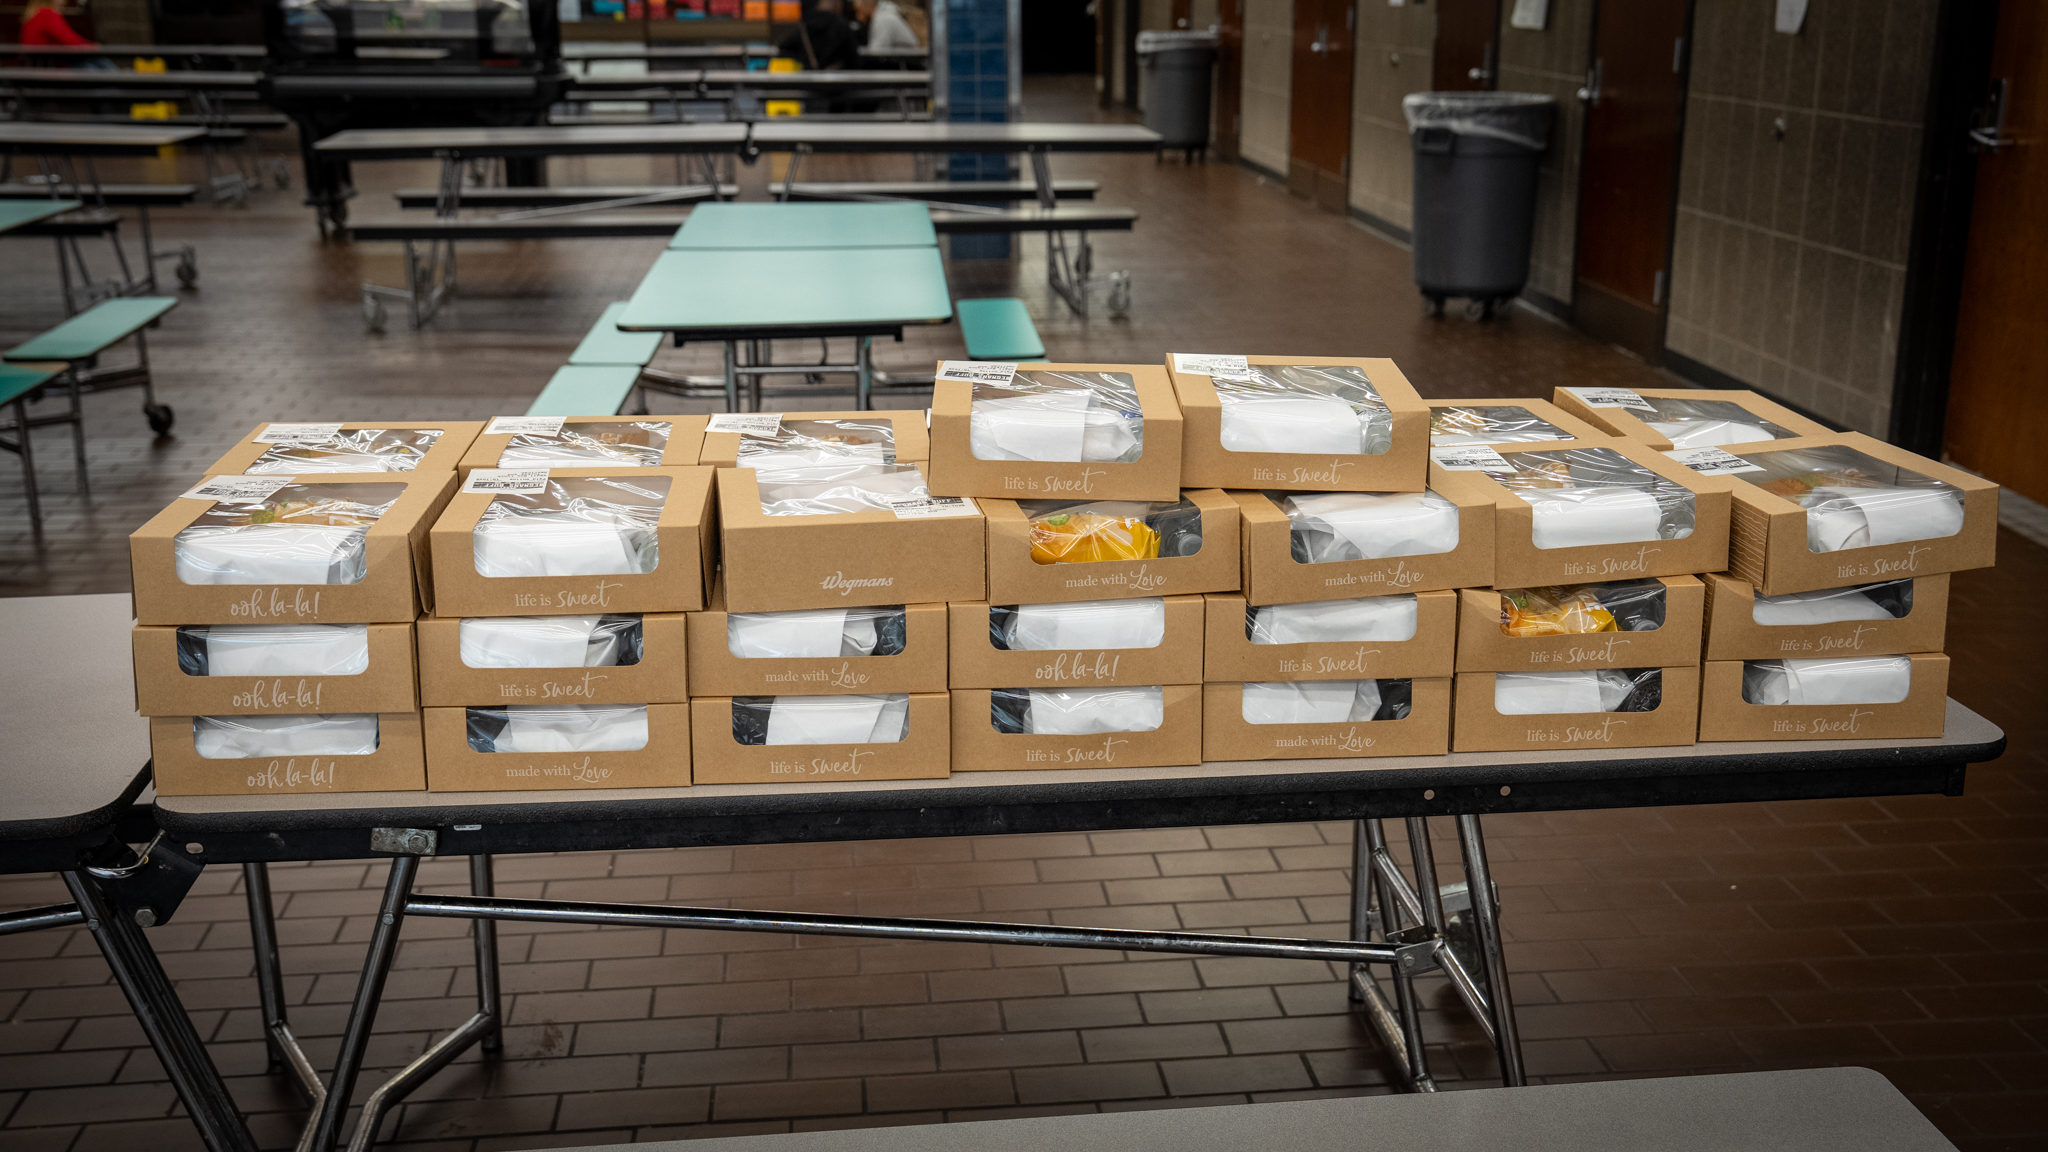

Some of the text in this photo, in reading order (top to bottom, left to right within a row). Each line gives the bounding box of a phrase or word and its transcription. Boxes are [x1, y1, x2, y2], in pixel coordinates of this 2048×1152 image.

[1005, 467, 1107, 494] life is sweet
[1254, 459, 1354, 484] life is sweet
[1564, 545, 1661, 575] life is sweet
[1838, 545, 1931, 578] life is sweet
[819, 571, 894, 596] Wegmans
[1066, 564, 1167, 590] made with Love
[1325, 561, 1424, 587] made with Love
[231, 588, 320, 618] ooh la-la!
[515, 580, 623, 607] life is sweet
[1530, 637, 1631, 663] life is sweet
[1780, 625, 1878, 652] life is sweet
[1035, 652, 1119, 681] ooh la-la!
[1280, 647, 1381, 673] life is sweet
[500, 672, 608, 698] life is sweet
[766, 662, 870, 688] made with Love
[233, 679, 322, 709] ooh la-la!
[1527, 717, 1627, 743] life is sweet
[1773, 709, 1874, 733] life is sweet
[1026, 737, 1128, 763] life is sweet
[1276, 727, 1376, 752] made with Love
[248, 758, 335, 788] ooh la-la!
[506, 756, 614, 783] made with Love
[770, 748, 875, 775] life is sweet
